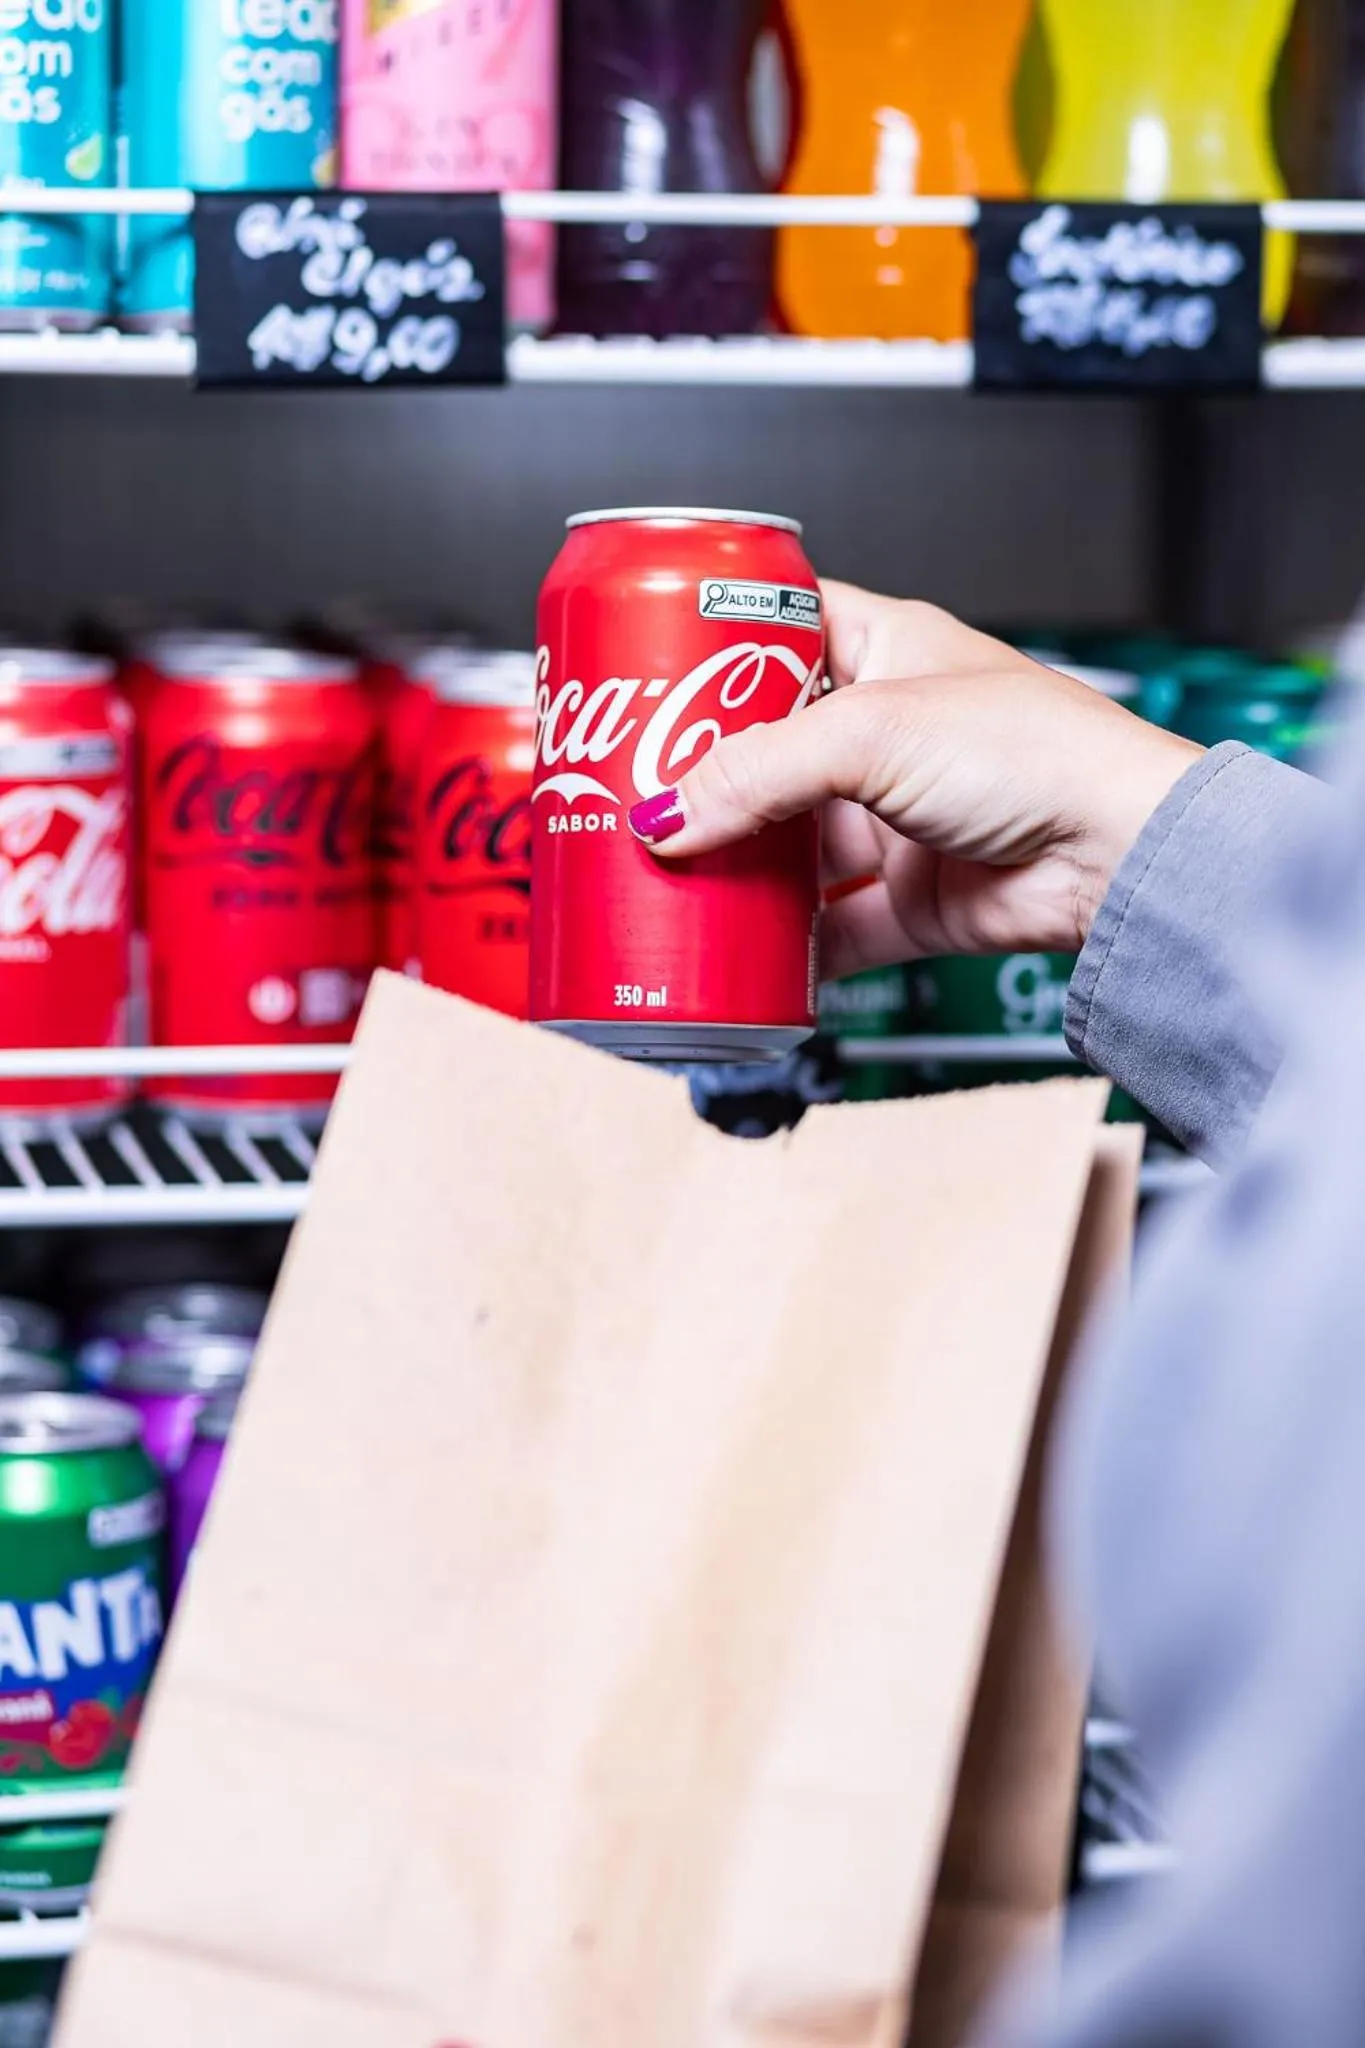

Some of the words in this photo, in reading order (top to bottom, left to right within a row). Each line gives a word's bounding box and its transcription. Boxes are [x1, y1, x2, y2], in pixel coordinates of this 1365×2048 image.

[0, 36, 73, 78] om
[0, 74, 62, 124] ás
[728, 594, 757, 607] ALTO
[760, 597, 774, 608] EM
[547, 812, 618, 834] SABOR
[613, 984, 642, 1007] 350
[646, 985, 667, 1007] ml
[0, 1569, 162, 1681] ANTA
